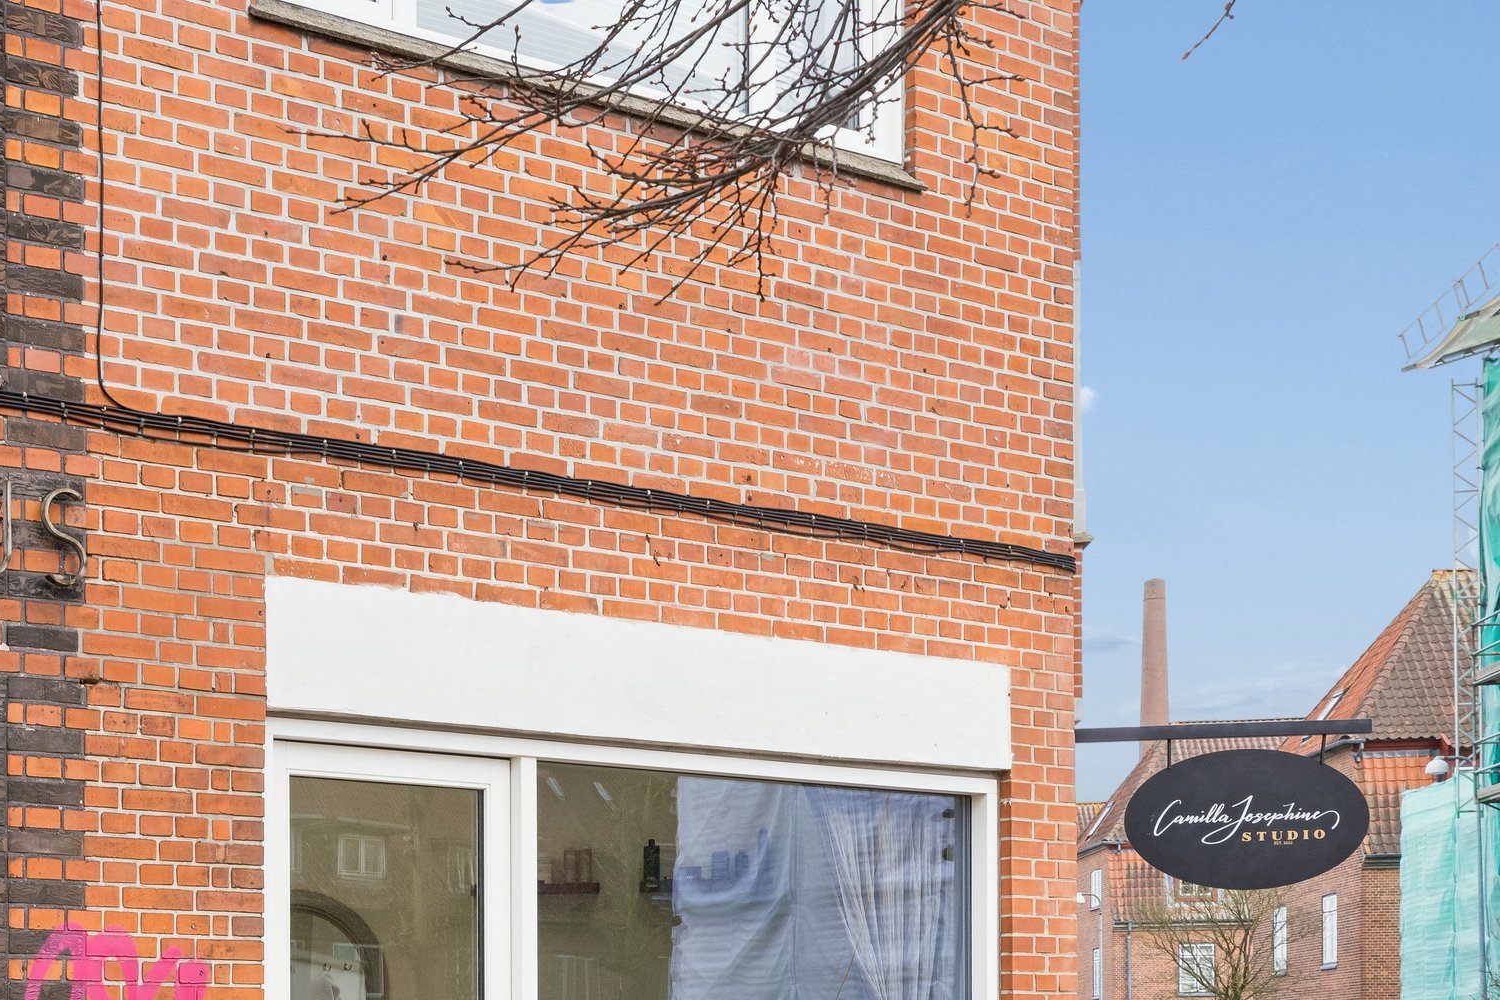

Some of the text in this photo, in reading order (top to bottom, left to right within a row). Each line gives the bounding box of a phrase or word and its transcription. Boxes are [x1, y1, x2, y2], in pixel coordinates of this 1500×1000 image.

[1153, 795, 1341, 845] Camilla Josephine
[1241, 828, 1326, 842] STUDIO
